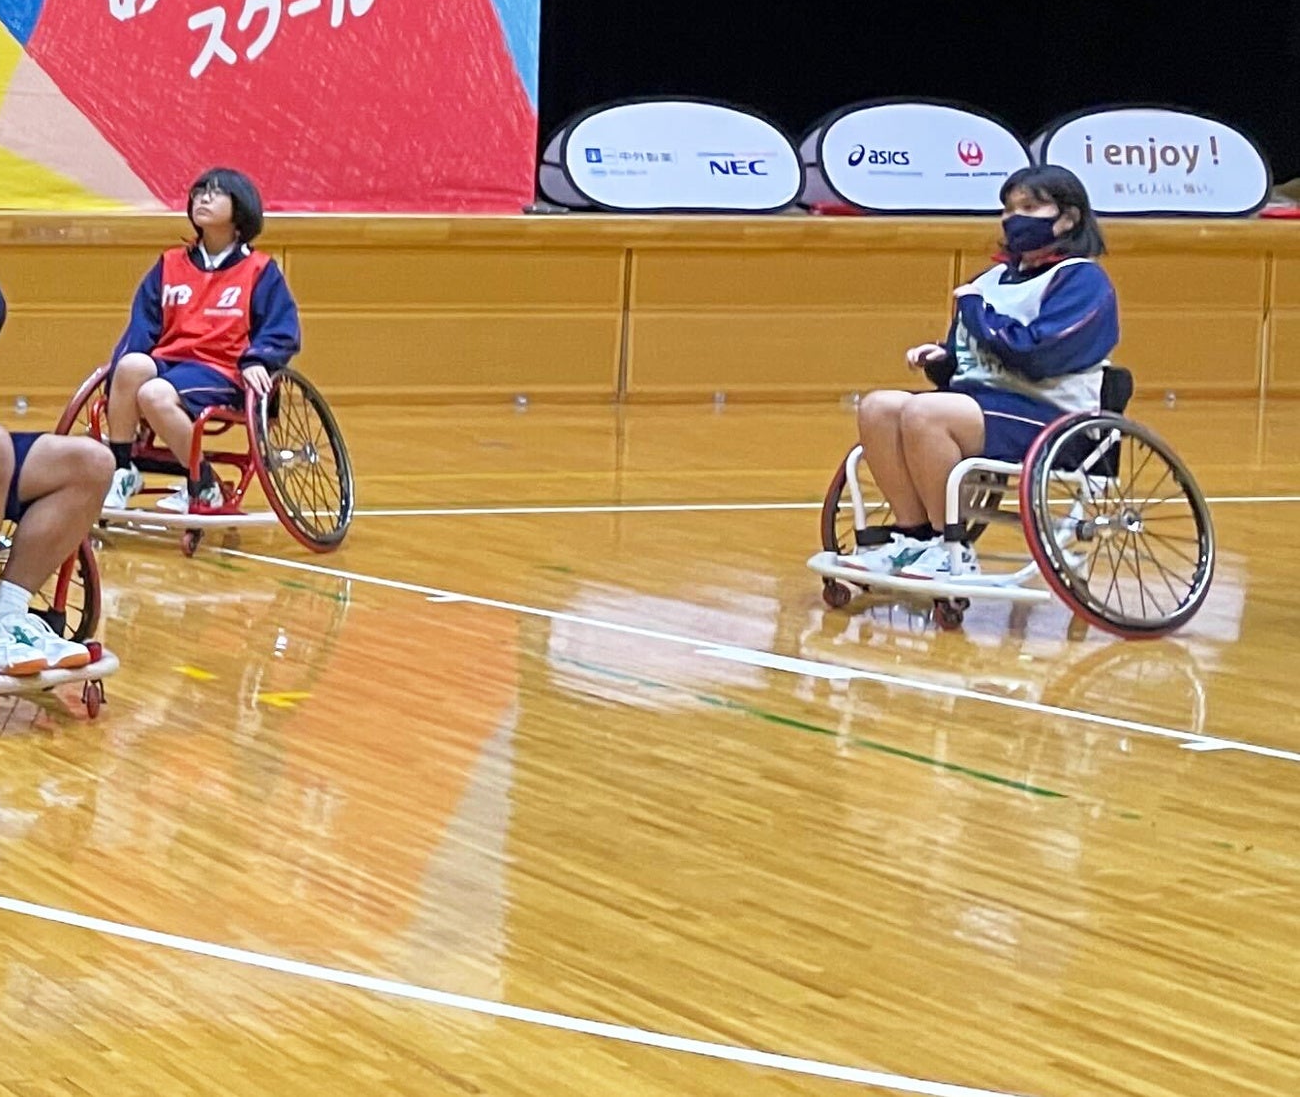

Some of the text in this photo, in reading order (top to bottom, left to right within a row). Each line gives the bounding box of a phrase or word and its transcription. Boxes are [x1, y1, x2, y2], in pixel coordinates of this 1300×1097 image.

[868, 149, 911, 166] asics
[1085, 135, 1094, 165] i
[1103, 137, 1200, 175] enjoy
[709, 160, 768, 176] NEC
